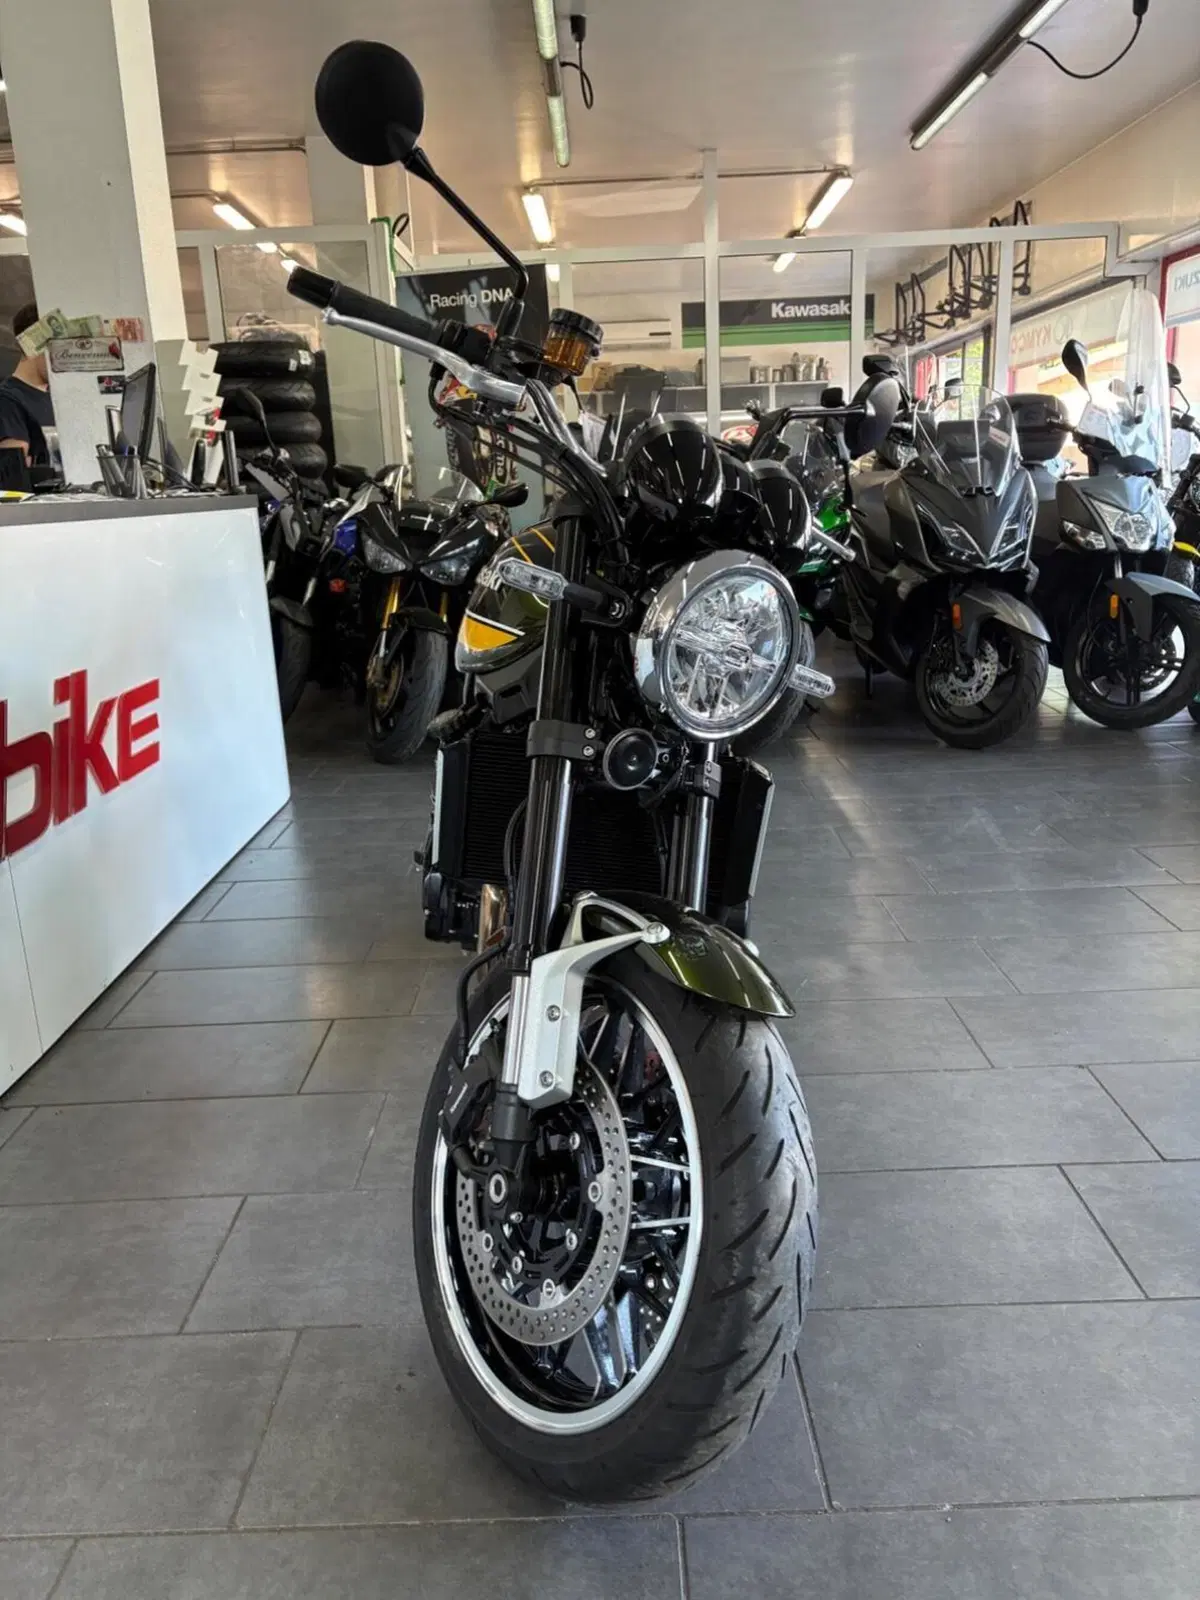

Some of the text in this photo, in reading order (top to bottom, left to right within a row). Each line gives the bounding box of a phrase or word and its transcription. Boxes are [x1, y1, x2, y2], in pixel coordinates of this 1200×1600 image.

[430, 287, 514, 308] Racing DNA
[771, 300, 851, 319] Kawasak
